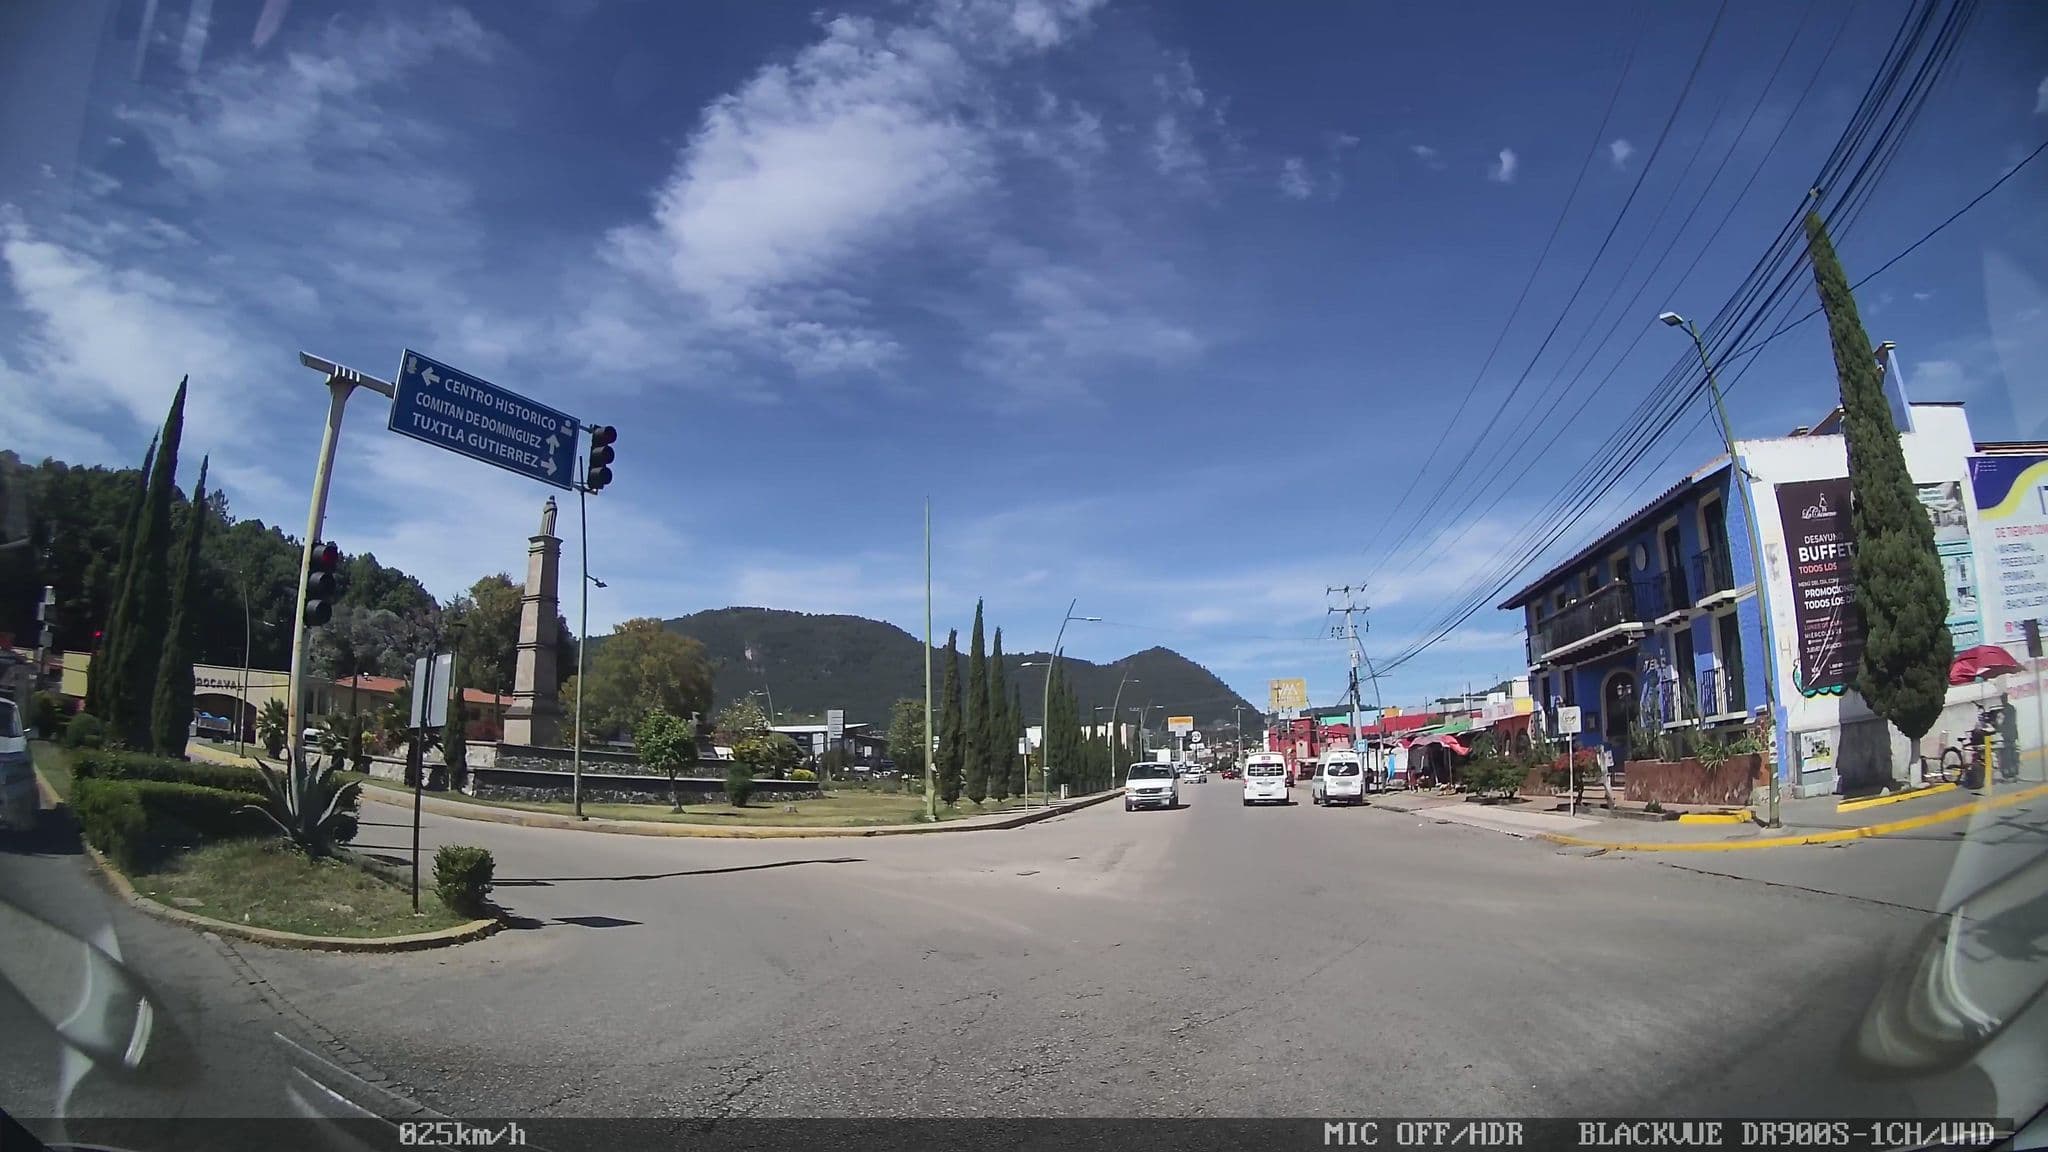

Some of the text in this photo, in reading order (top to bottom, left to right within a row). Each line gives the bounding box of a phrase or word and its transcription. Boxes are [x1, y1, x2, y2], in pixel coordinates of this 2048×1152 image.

[416, 392, 542, 449] COMITAN DE DOMINGUEZ
[445, 378, 556, 431] CENTRO HISTORICO
[412, 411, 539, 468] TUXTLA GUTIERREZ
[1798, 541, 1855, 563] BUFFET
[1798, 561, 1837, 575] TODOS LOS
[1804, 598, 1830, 610] TODOS
